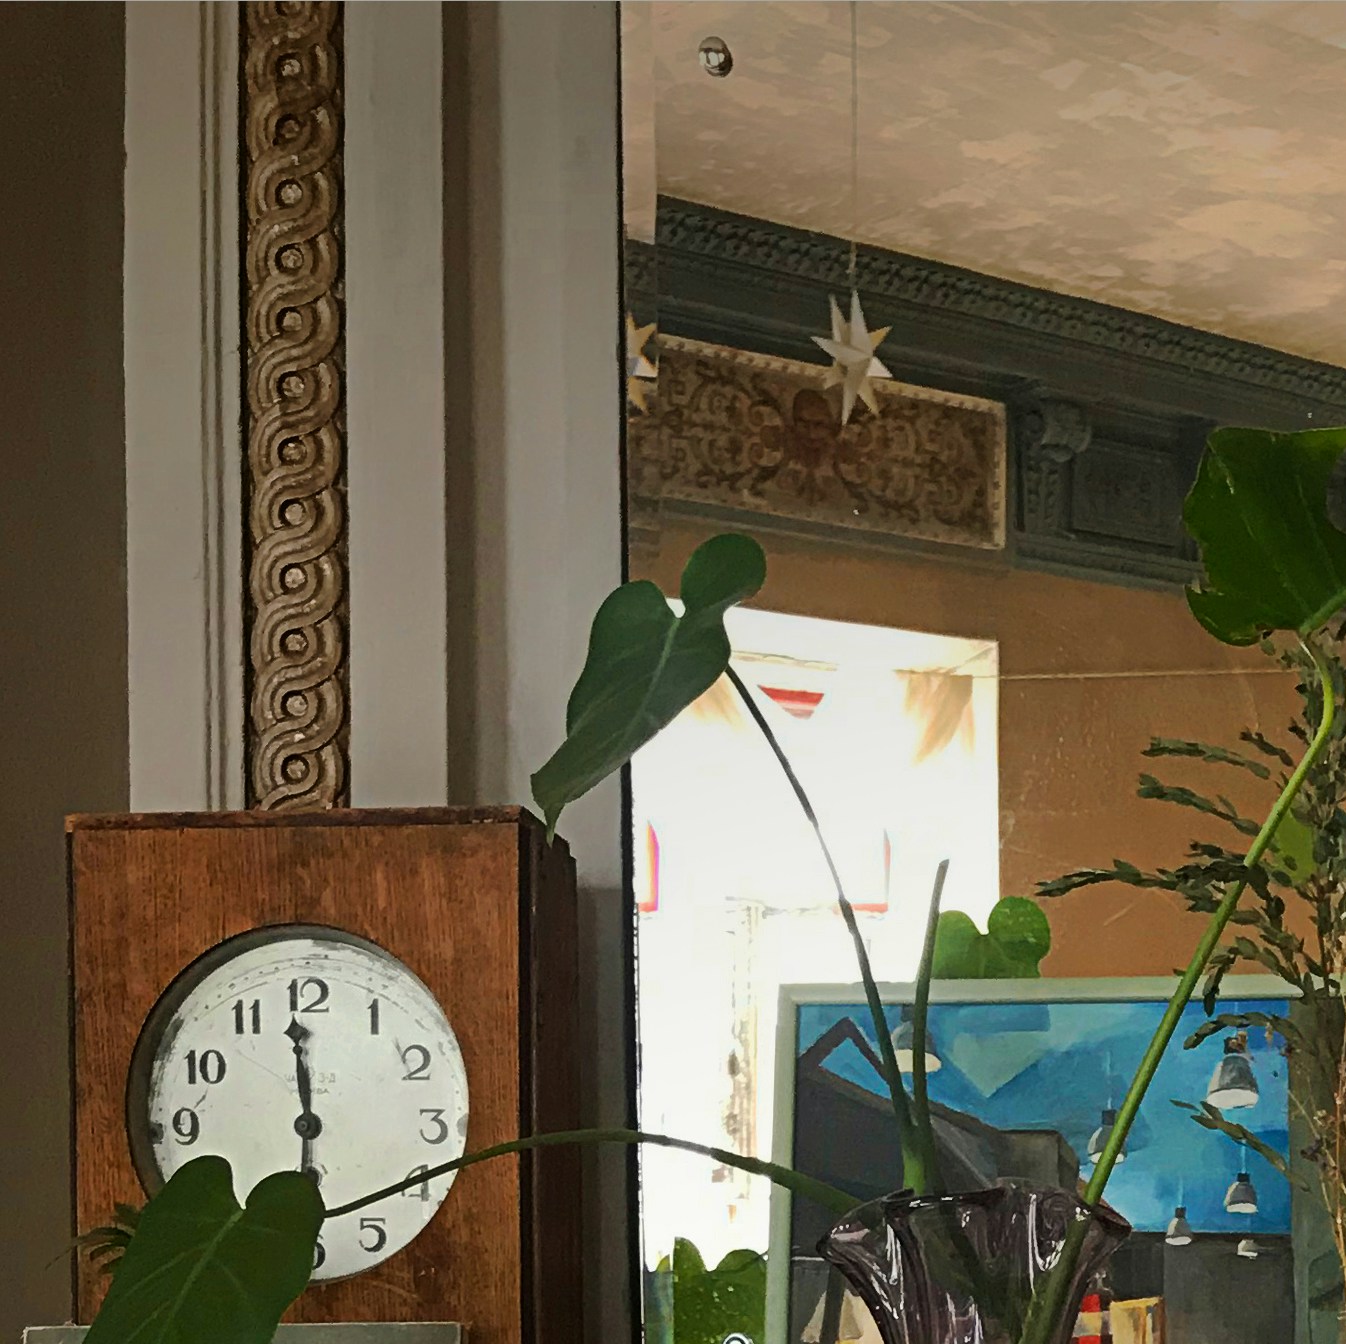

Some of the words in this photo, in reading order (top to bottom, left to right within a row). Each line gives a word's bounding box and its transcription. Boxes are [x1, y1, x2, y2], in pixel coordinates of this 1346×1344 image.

[287, 978, 330, 1013] 12
[232, 999, 261, 1034] 11
[368, 998, 380, 1035] 1
[184, 1049, 227, 1084] 10
[401, 1045, 432, 1080] 2
[172, 1107, 200, 1145] 9
[419, 1108, 449, 1144] 3
[359, 1217, 387, 1253] 5
